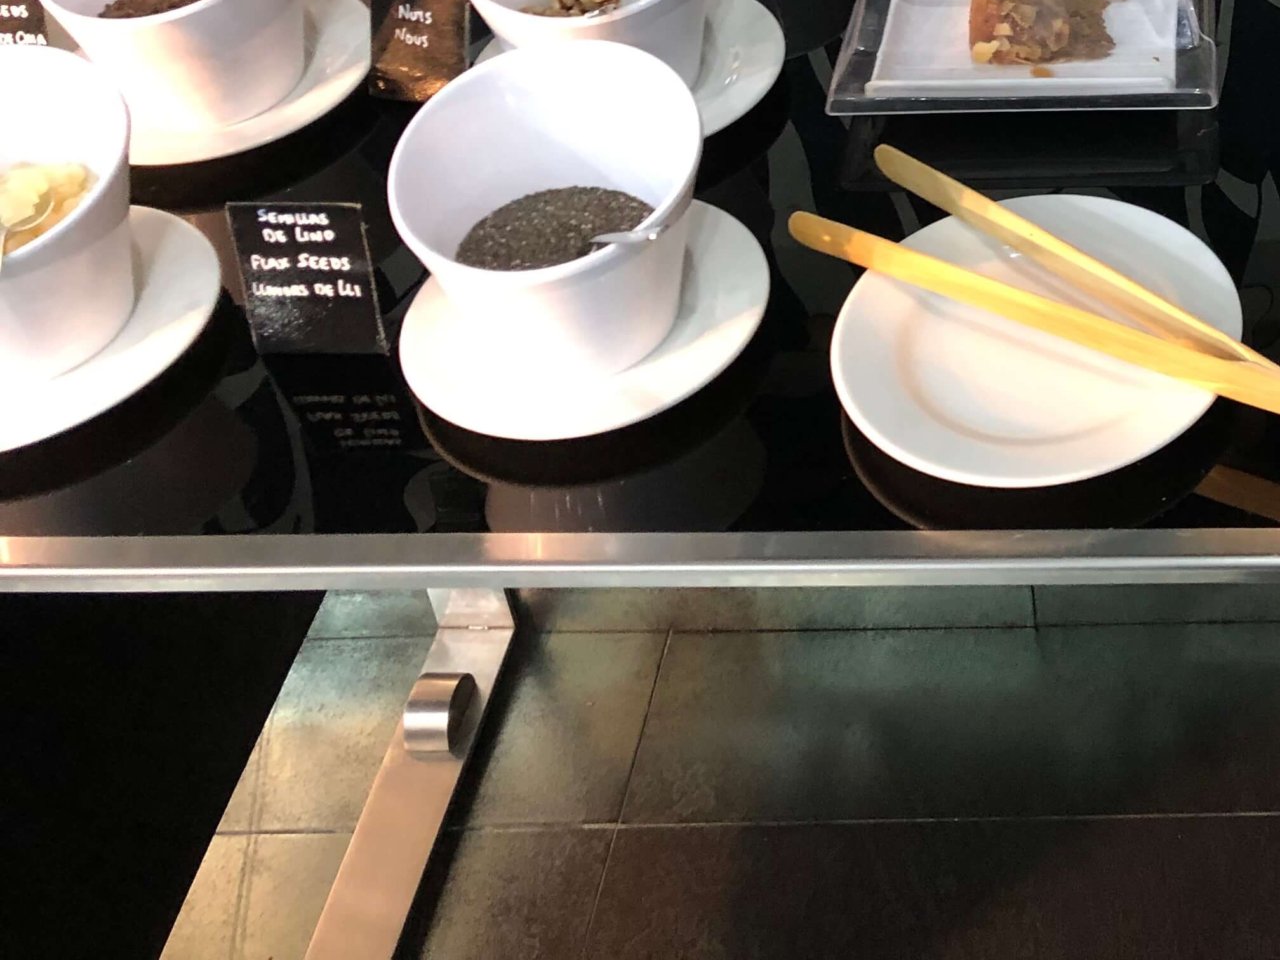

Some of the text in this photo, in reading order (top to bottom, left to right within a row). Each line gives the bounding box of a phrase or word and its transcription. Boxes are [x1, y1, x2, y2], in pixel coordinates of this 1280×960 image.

[398, 3, 433, 25] NUTS
[394, 28, 430, 49] NOUS
[256, 208, 329, 226] SEMILLAS
[261, 226, 336, 243] DE LINO
[250, 252, 351, 272] FLAX SEEDS
[313, 283, 335, 297] DE
